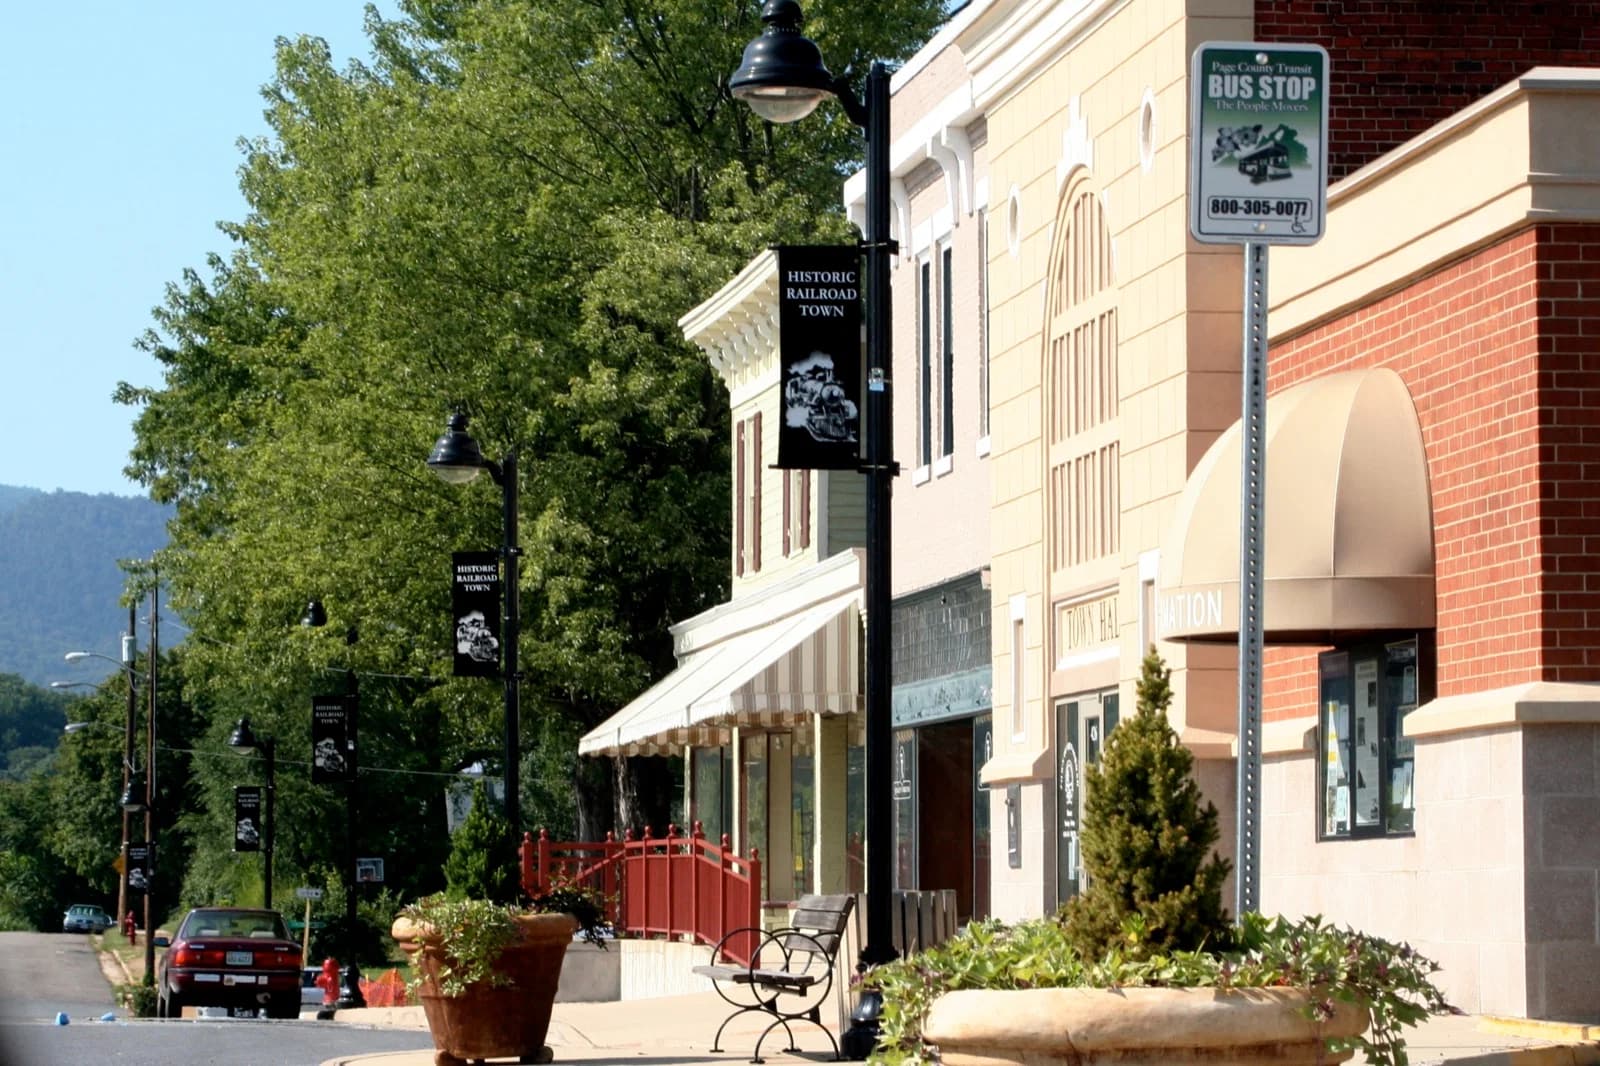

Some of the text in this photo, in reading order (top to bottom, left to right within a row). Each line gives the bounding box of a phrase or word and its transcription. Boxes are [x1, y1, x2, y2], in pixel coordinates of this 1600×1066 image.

[1212, 61, 1312, 75] Page County Transit
[1208, 74, 1316, 100] BUS STOP
[1216, 100, 1308, 113] The People Movers
[1211, 199, 1308, 216] 800-305-0077
[787, 270, 856, 283] HISTORIC
[786, 287, 857, 300] RAILROAD
[799, 304, 844, 317] TOWN
[457, 565, 497, 573] HISTORIC
[456, 574, 498, 582] RAILROAD
[464, 583, 491, 591] TOWN
